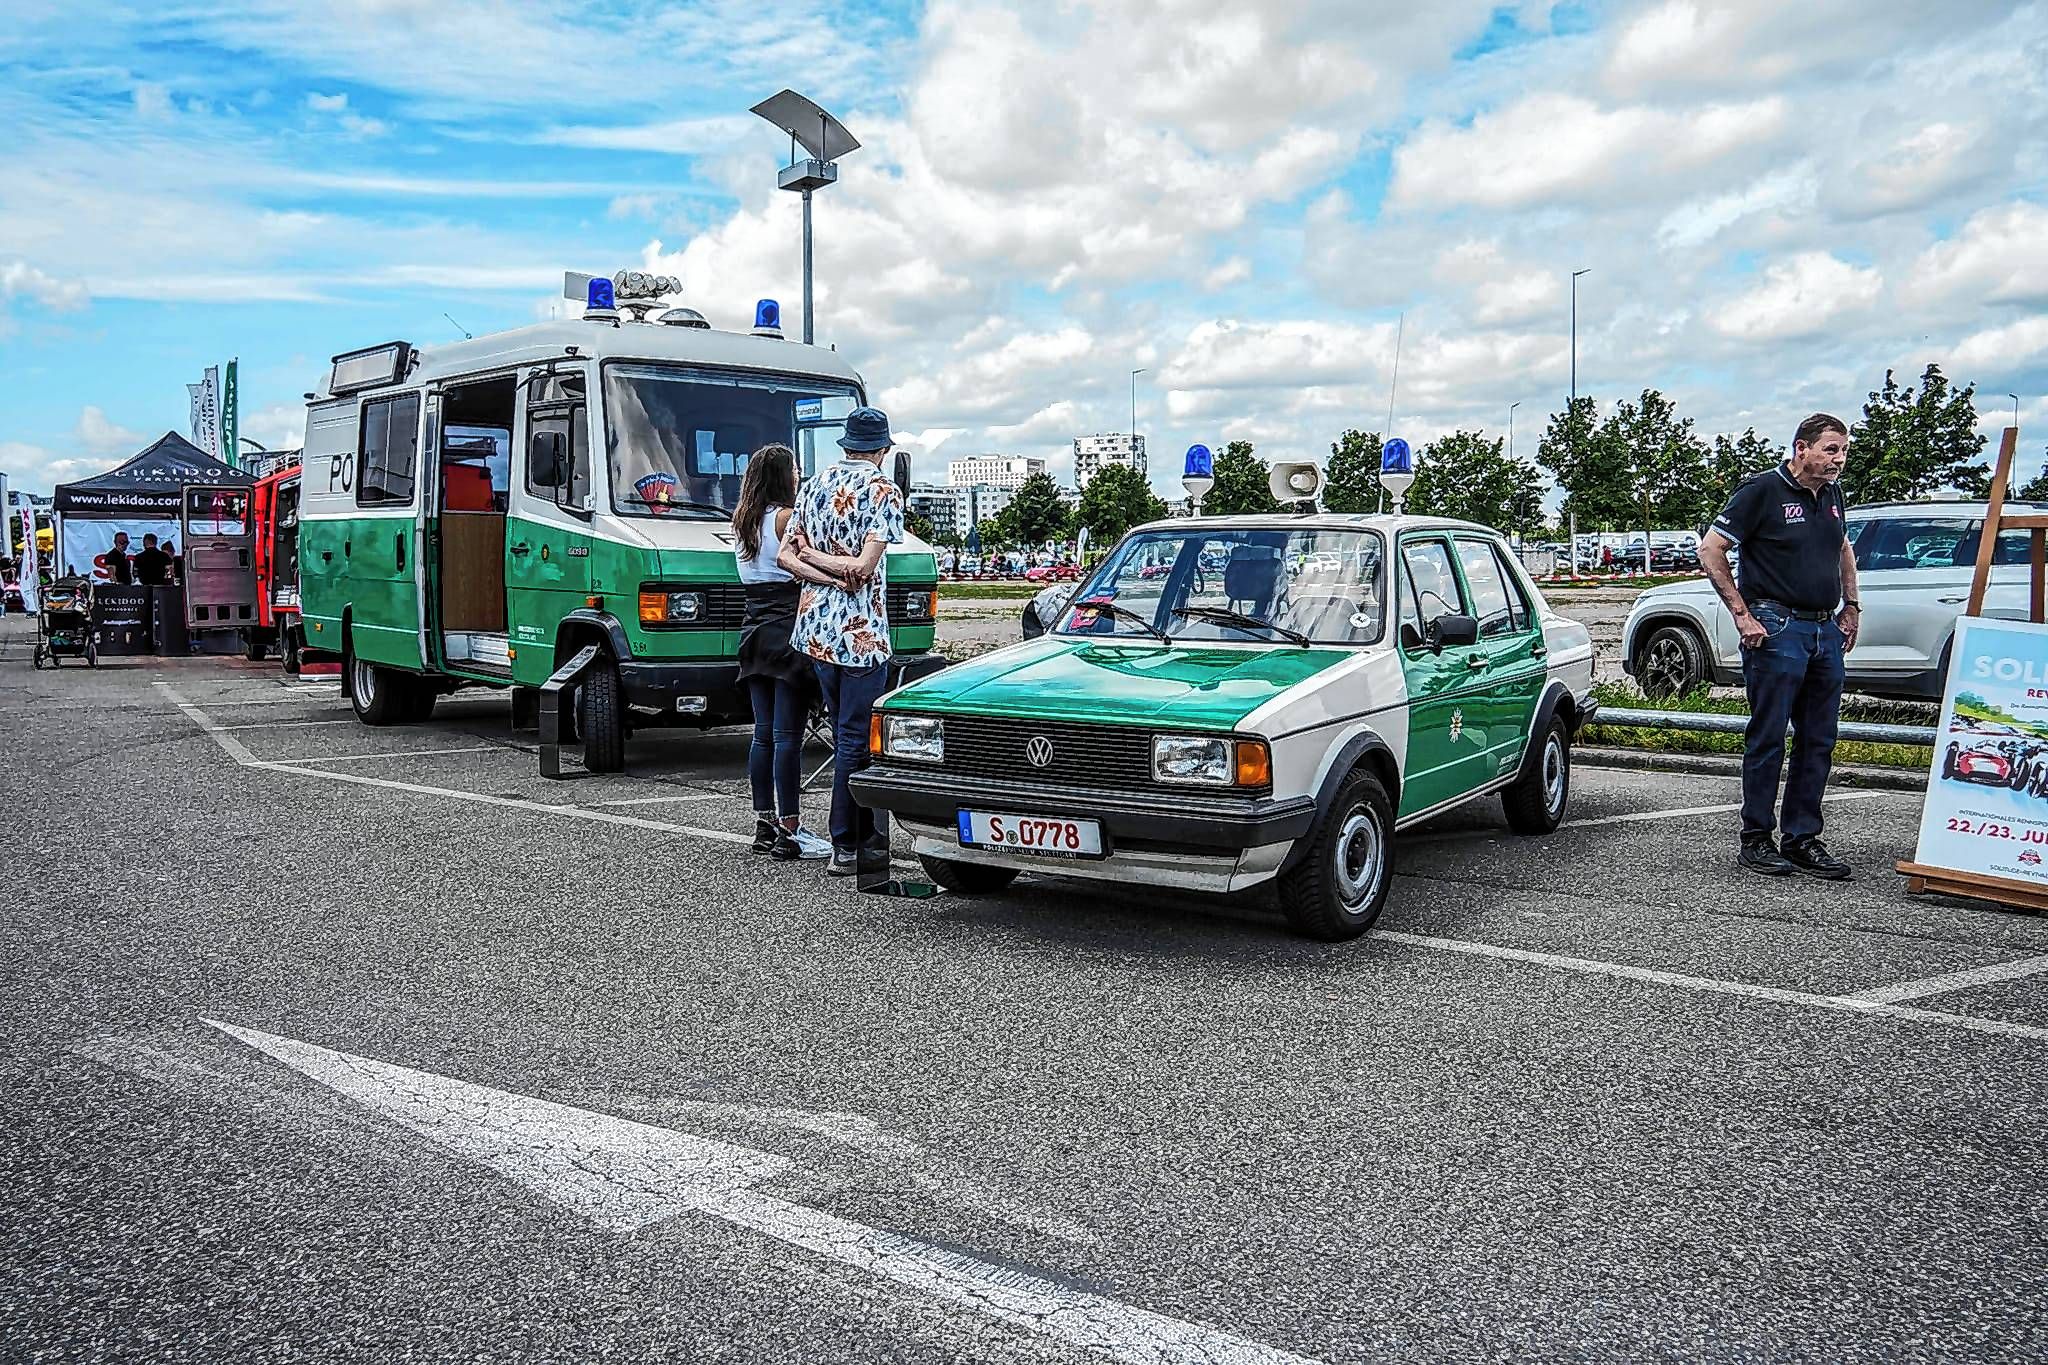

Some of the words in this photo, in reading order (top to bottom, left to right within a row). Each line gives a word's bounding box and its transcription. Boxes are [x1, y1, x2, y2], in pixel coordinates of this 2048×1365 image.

[989, 816, 1005, 843] S
[1019, 819, 1080, 850] 0778
[1946, 818, 2016, 840] 22./23.
